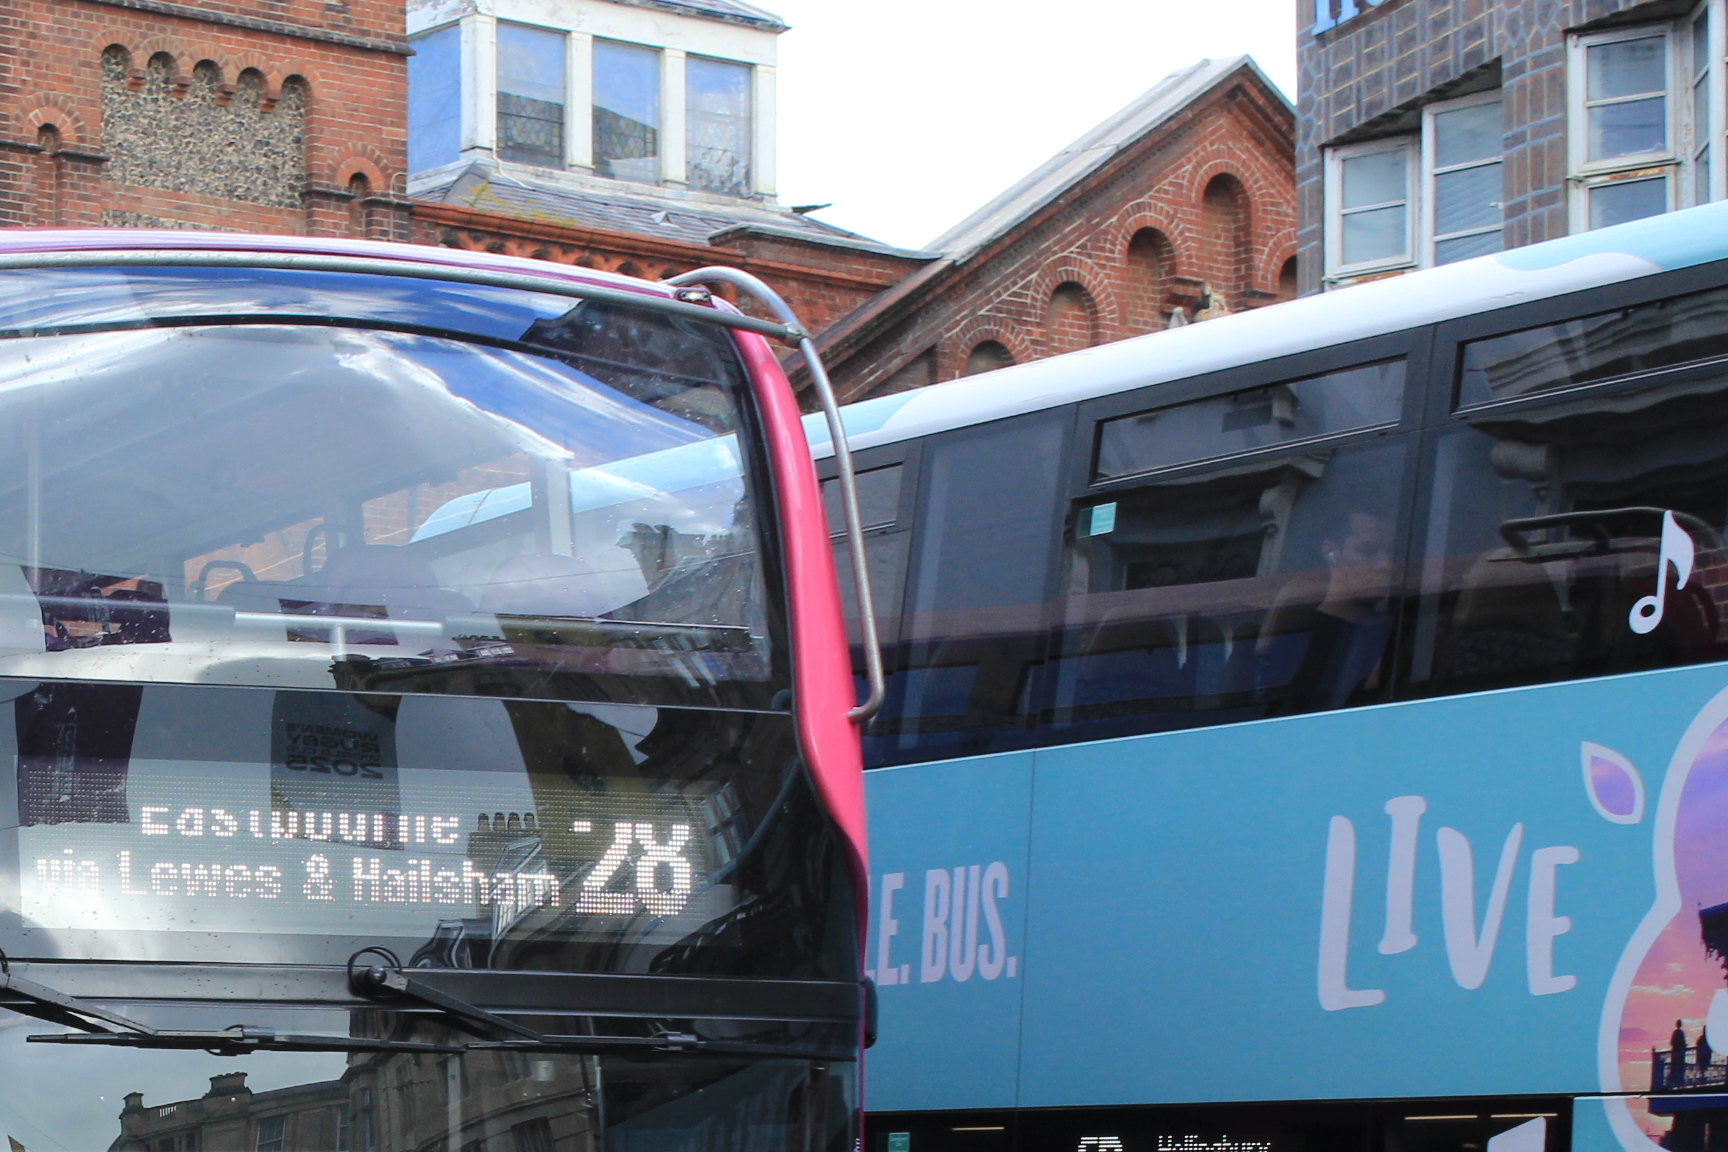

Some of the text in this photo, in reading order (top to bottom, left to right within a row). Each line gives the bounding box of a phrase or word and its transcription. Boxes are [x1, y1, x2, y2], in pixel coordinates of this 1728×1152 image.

[37, 848, 560, 907] via Lewes & Hailsham
[573, 821, 691, 916] 28
[920, 861, 1018, 983] BUS.
[1317, 795, 1580, 1012] LIVE
